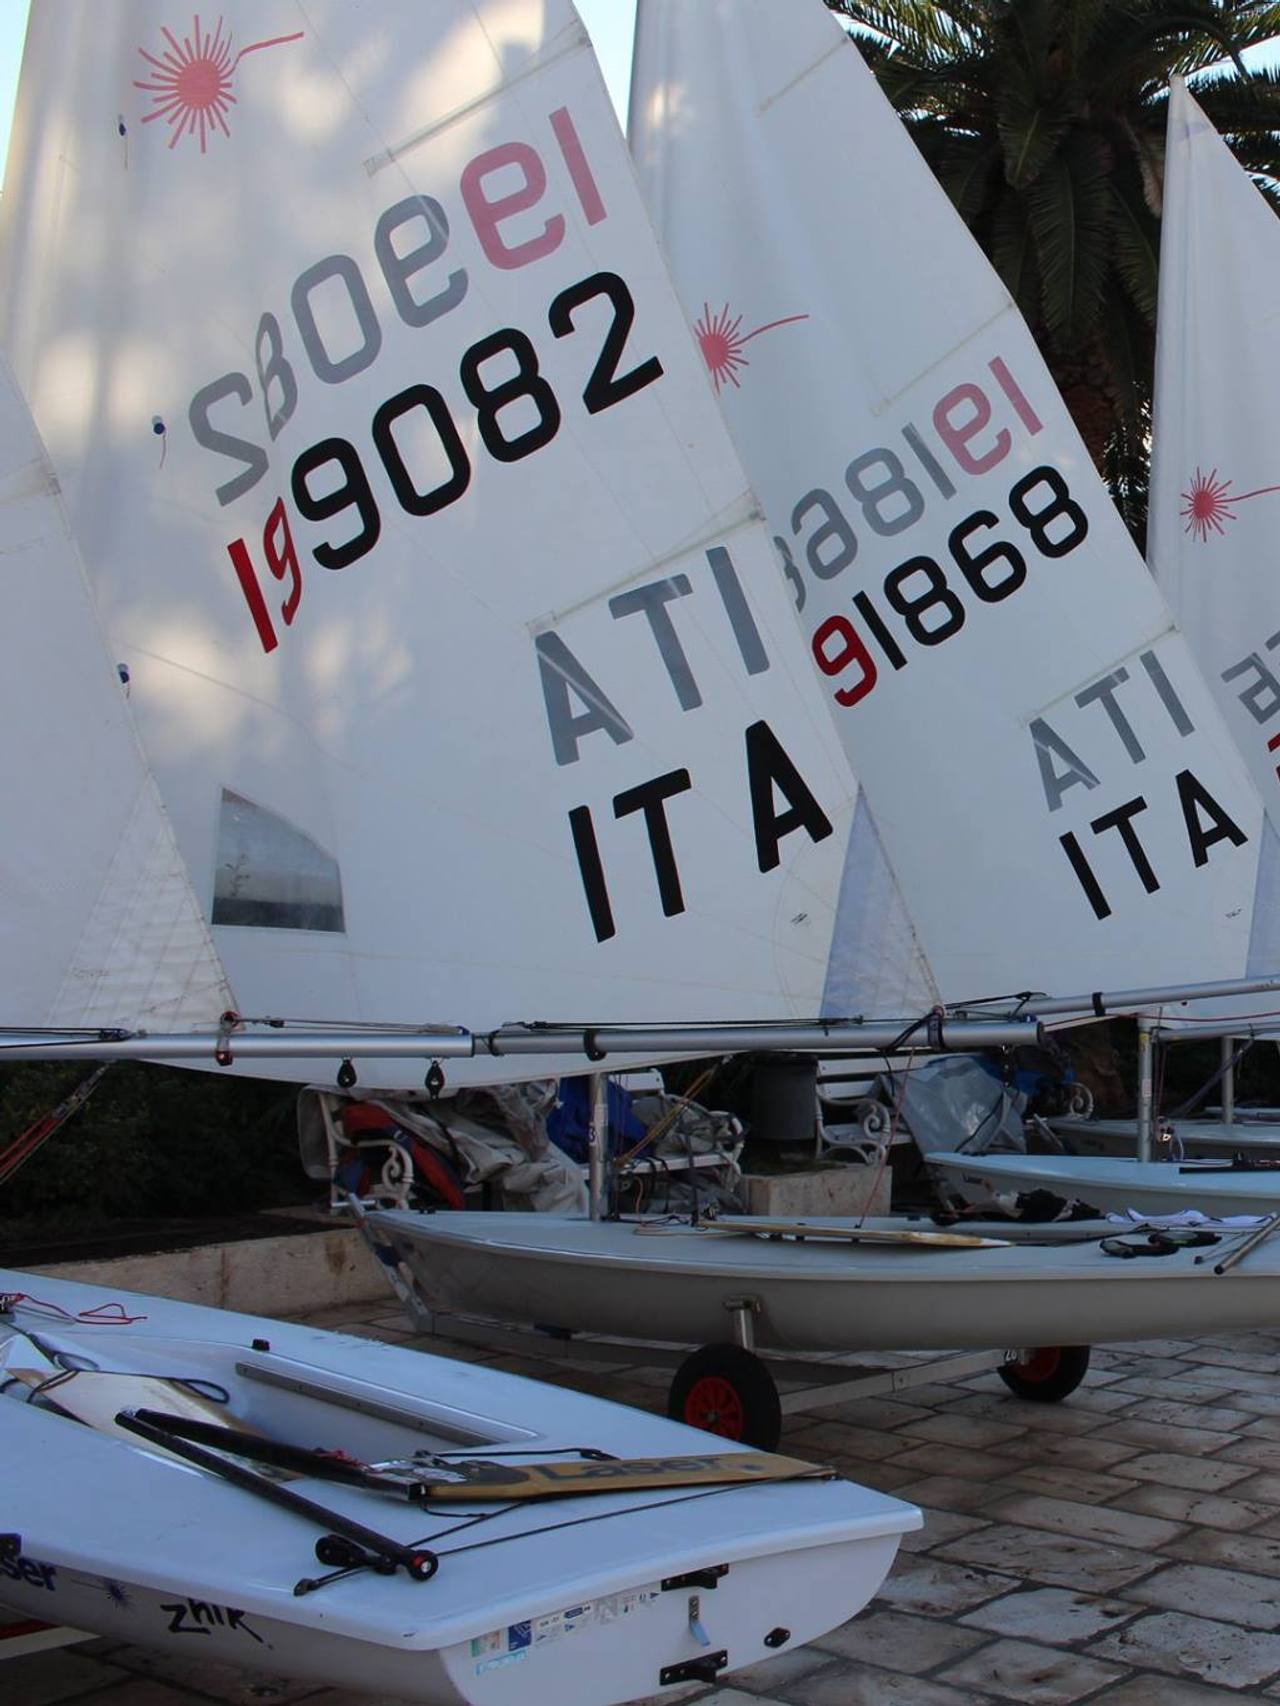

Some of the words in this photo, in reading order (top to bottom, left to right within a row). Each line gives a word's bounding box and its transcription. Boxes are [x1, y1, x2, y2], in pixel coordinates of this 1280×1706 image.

[227, 271, 664, 654] 199082
[567, 719, 833, 943] ITA
[1058, 769, 1248, 920] ITA
[532, 1457, 723, 1482] Laser
